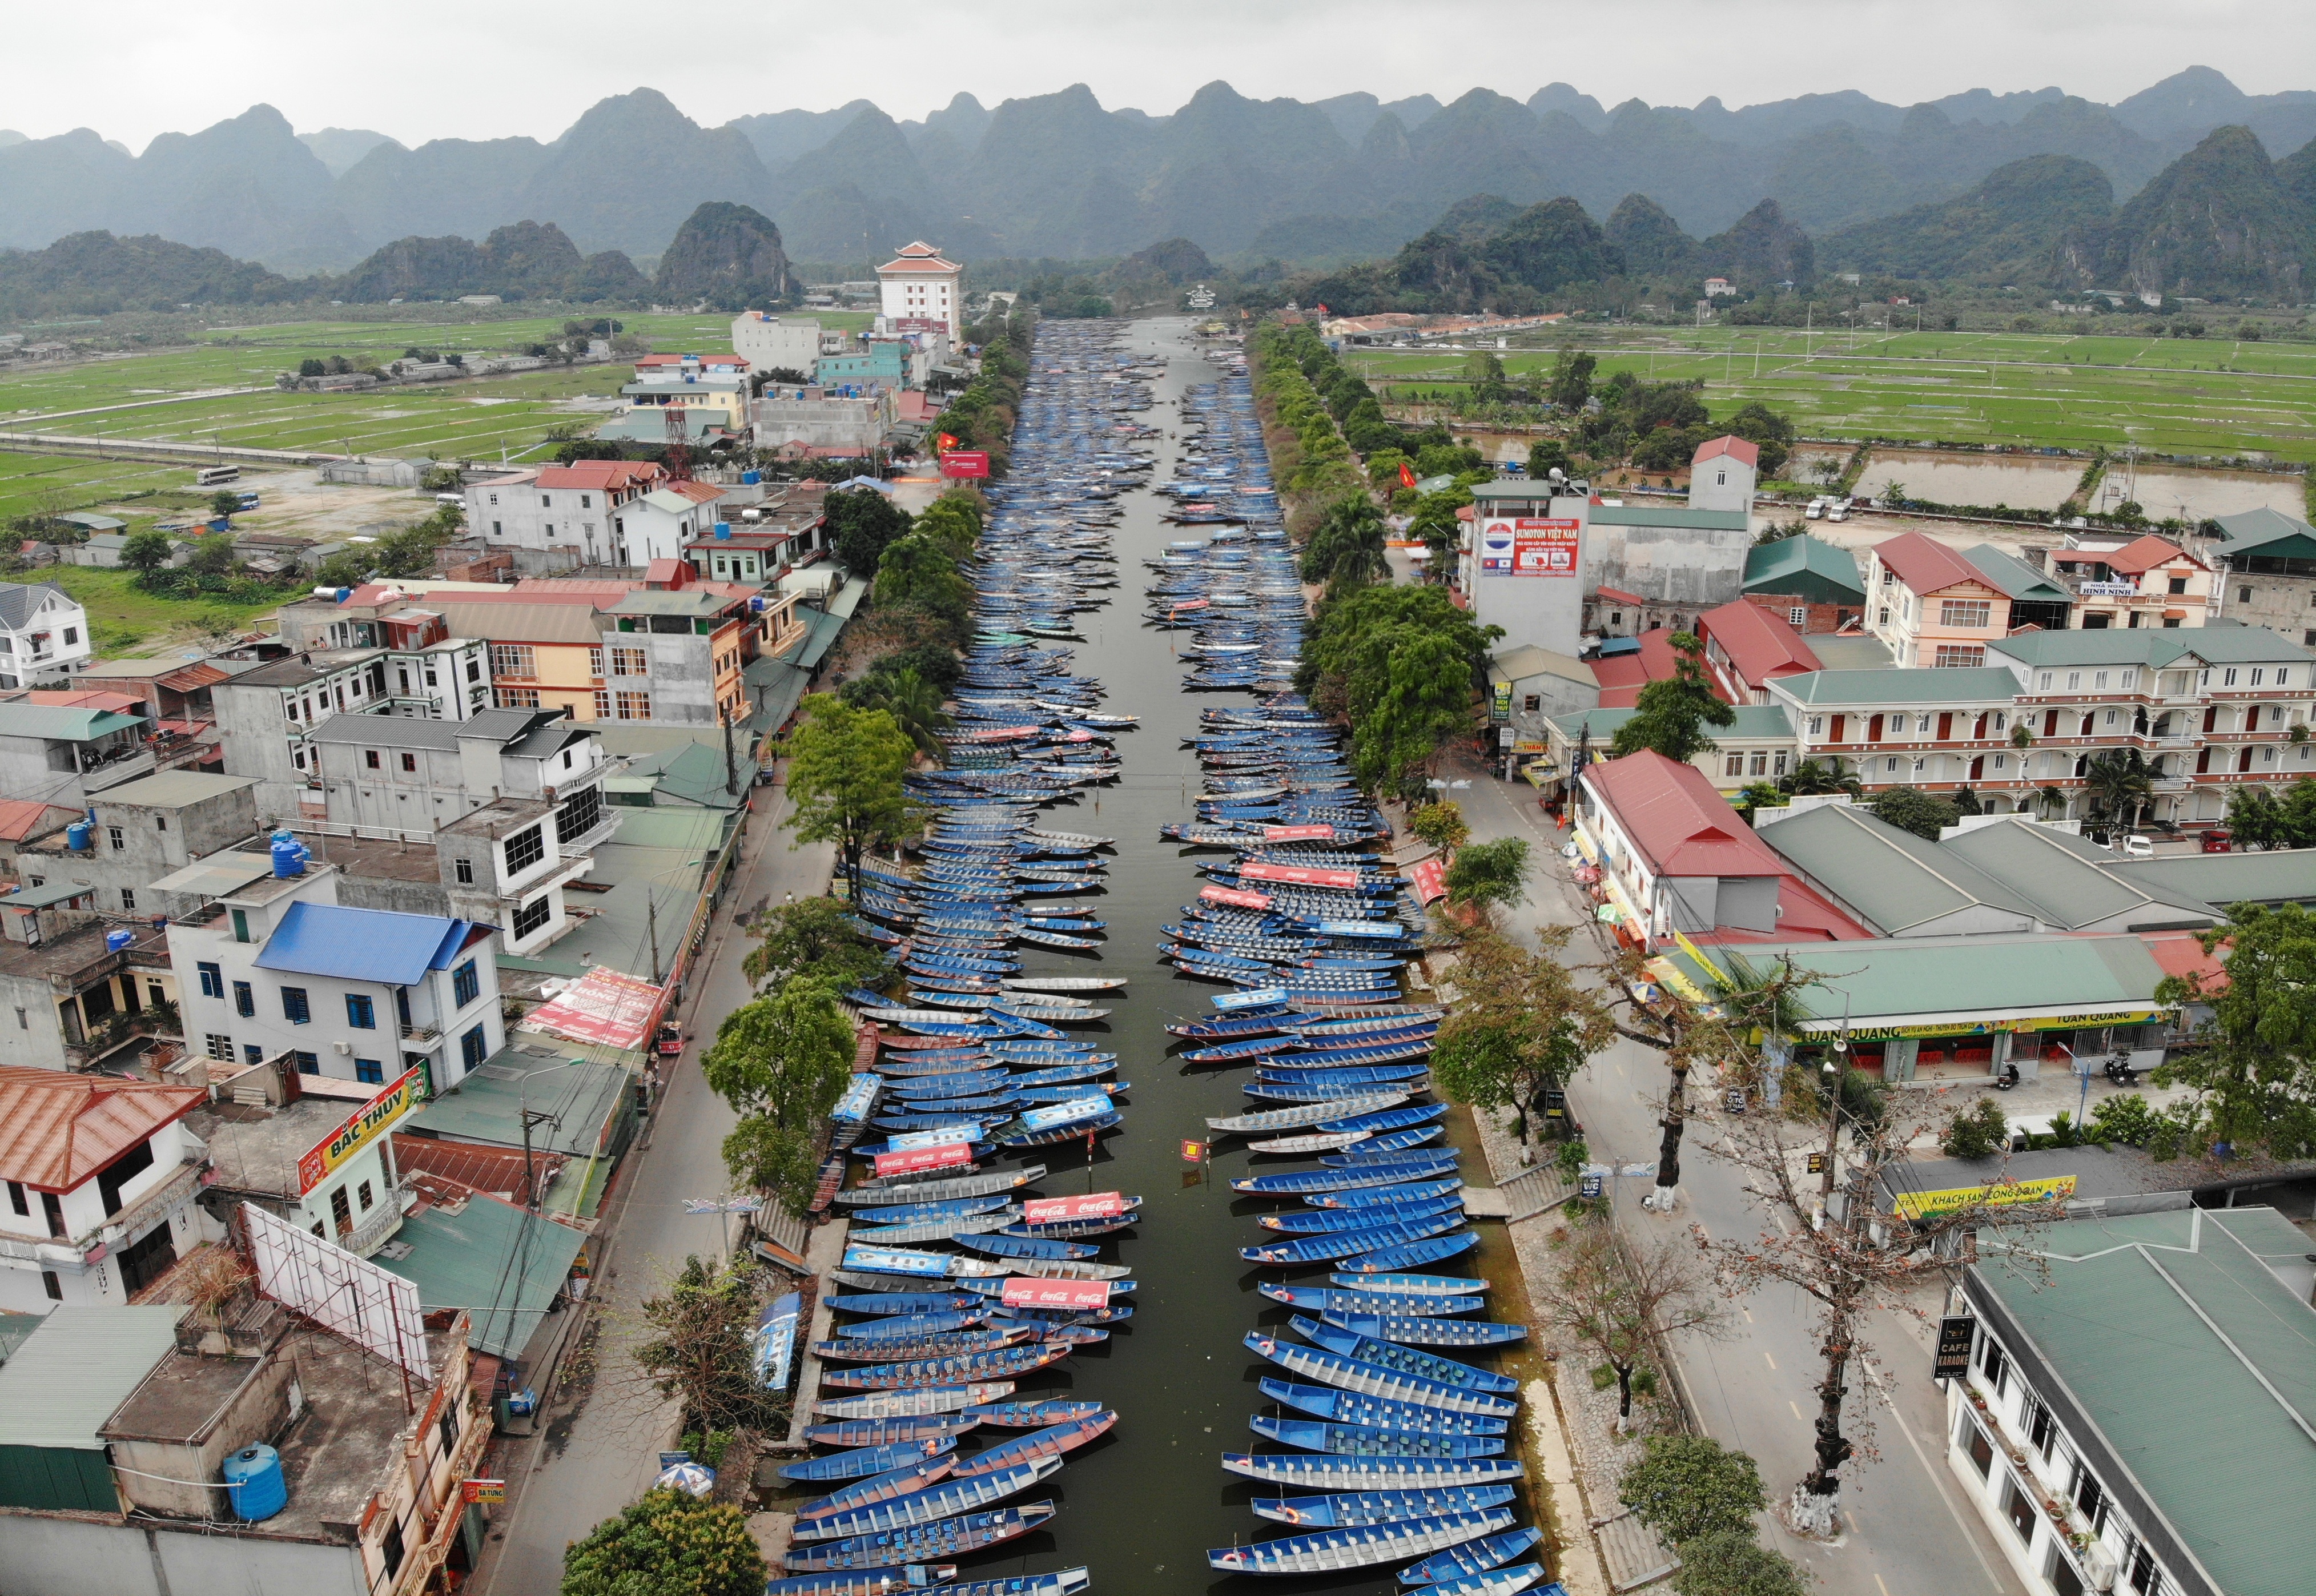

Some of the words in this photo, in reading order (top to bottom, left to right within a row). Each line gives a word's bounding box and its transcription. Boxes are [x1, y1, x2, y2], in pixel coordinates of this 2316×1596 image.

[1516, 529, 1546, 539] SUMOTON
[1547, 526, 1562, 541] VIỆT
[1563, 529, 1578, 538] NAM
[331, 1122, 360, 1159] BẮC
[363, 1090, 401, 1130] THỦY
[1932, 1192, 1965, 1205] KHÁCH
[1941, 1343, 1969, 1352] CAFE
[1937, 1354, 1969, 1366] KARAOKE
